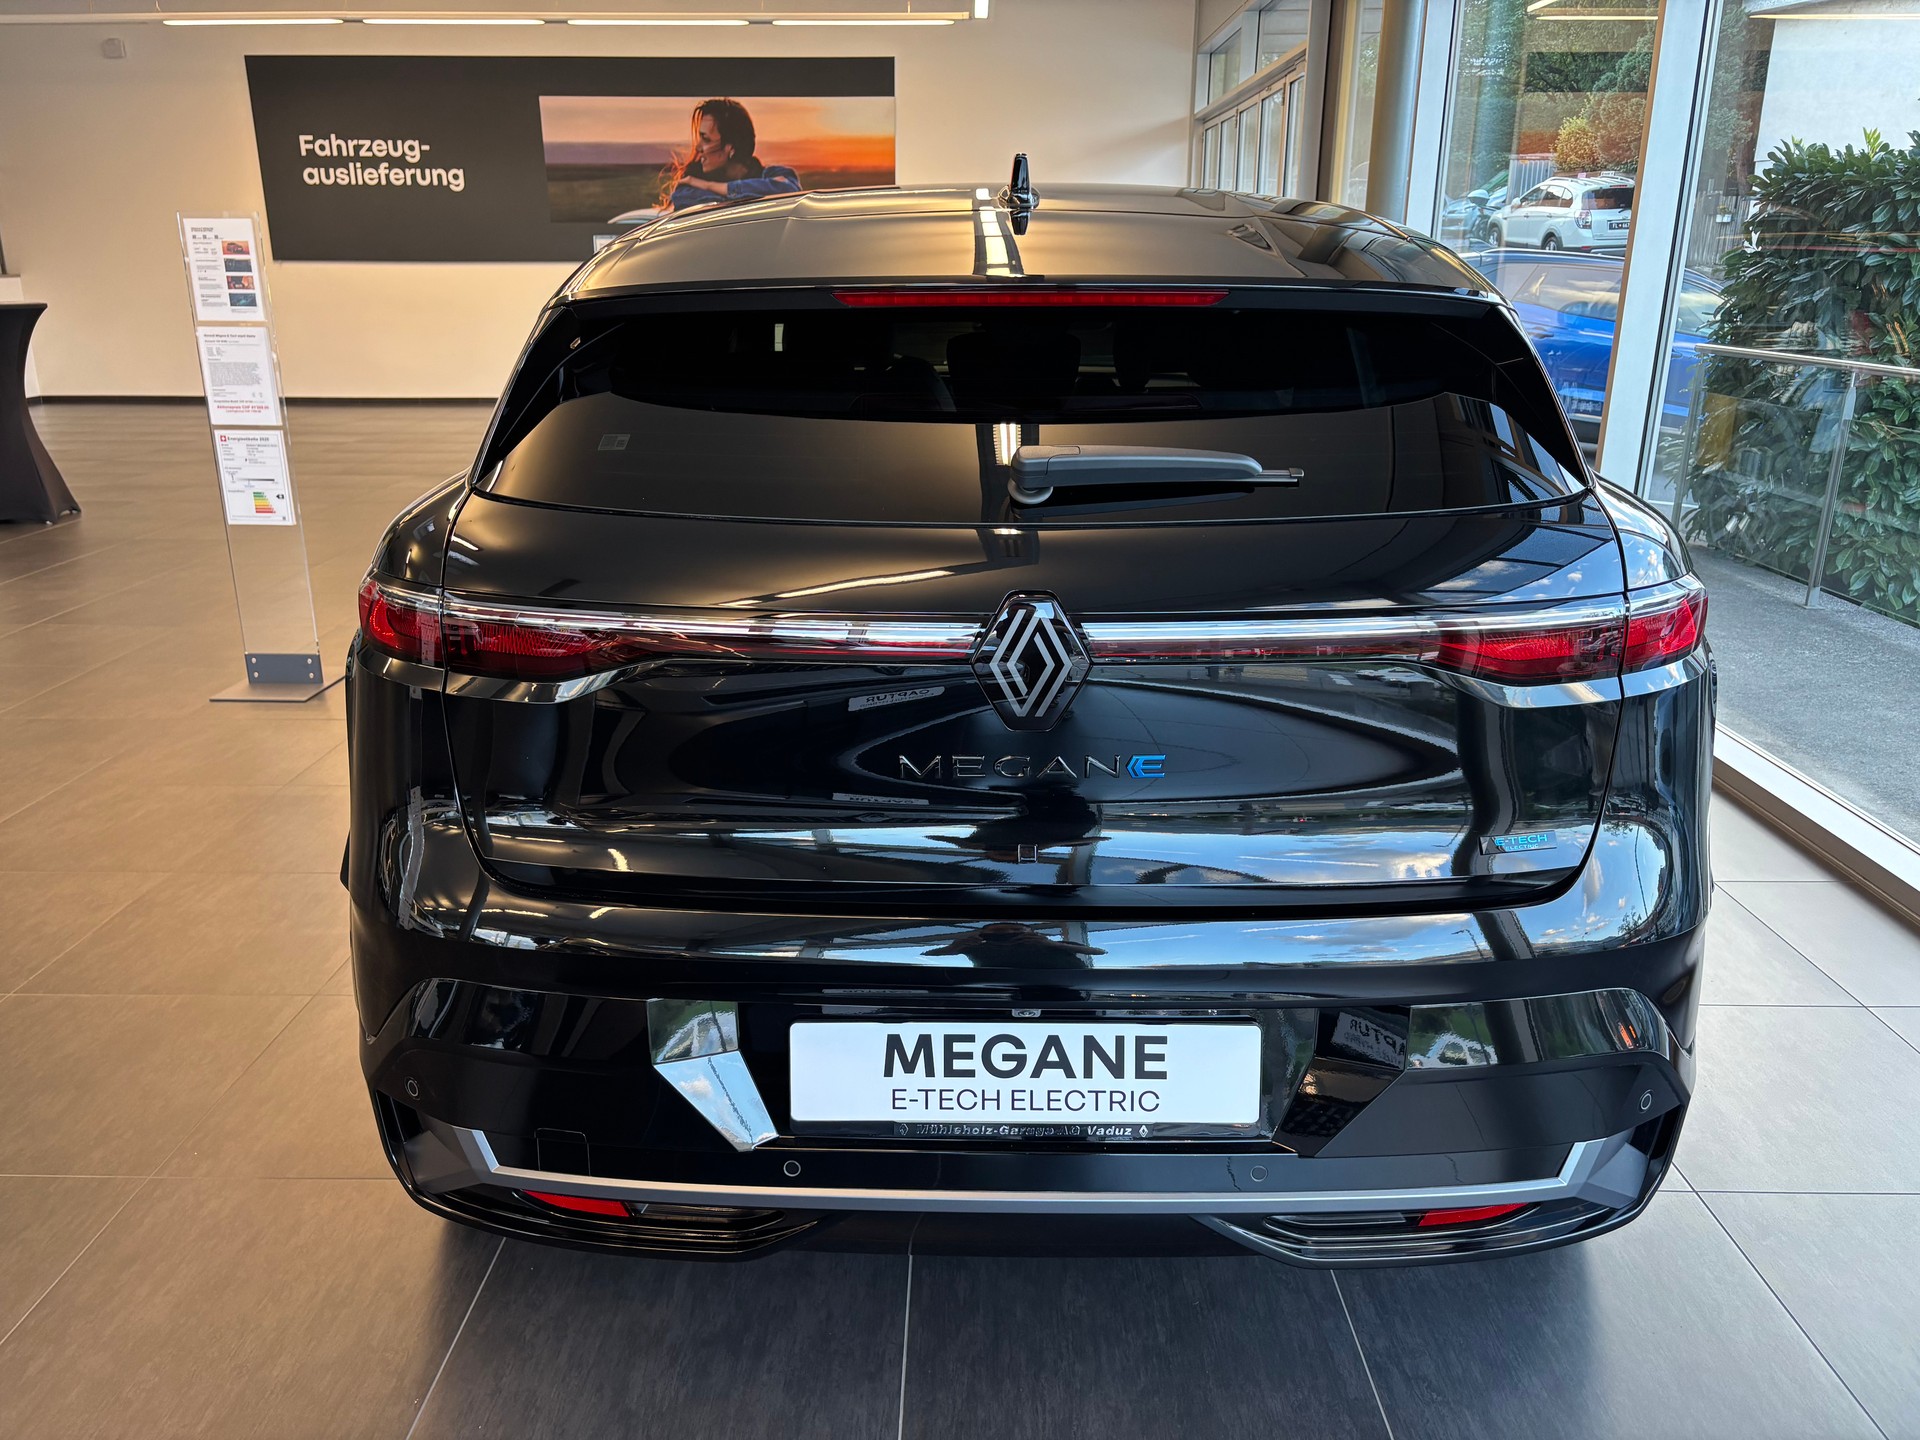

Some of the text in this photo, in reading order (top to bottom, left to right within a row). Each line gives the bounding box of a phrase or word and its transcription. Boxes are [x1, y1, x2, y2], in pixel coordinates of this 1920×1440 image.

[299, 134, 430, 163] Fahrzeug-
[303, 162, 465, 192] auslieferung
[899, 755, 1165, 778] MEGANE
[1495, 834, 1548, 846] E-TECH
[883, 1034, 1167, 1079] MEGANE
[892, 1089, 1160, 1111] E-TECH ELECTRIC
[1087, 1125, 1132, 1135] Vaduz
